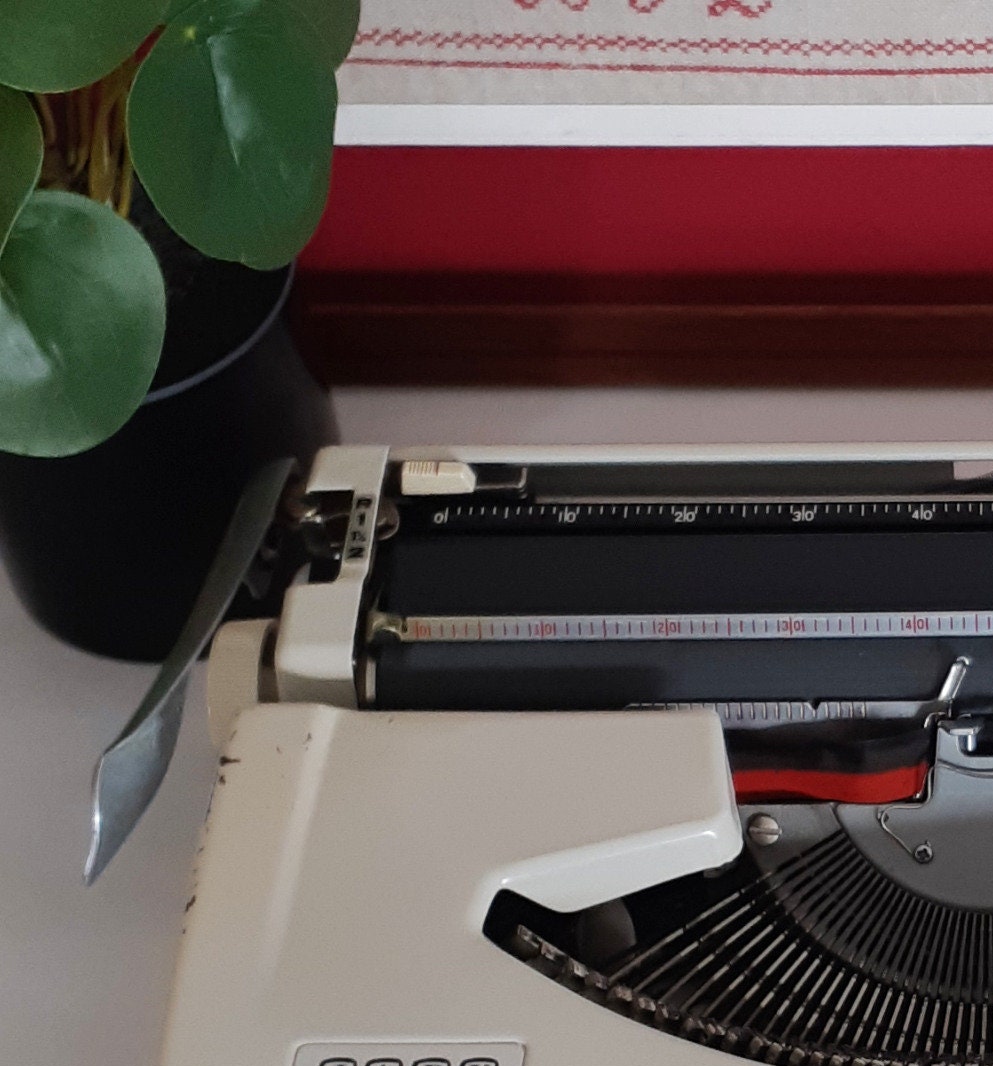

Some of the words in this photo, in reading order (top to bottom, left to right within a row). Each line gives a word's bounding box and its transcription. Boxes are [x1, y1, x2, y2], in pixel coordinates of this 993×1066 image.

[559, 511, 576, 523] 10
[674, 510, 697, 522] 20
[792, 509, 814, 522] 30
[912, 508, 932, 520] 40
[657, 622, 678, 634] 20
[781, 621, 802, 633] 30
[905, 619, 925, 630] 40
